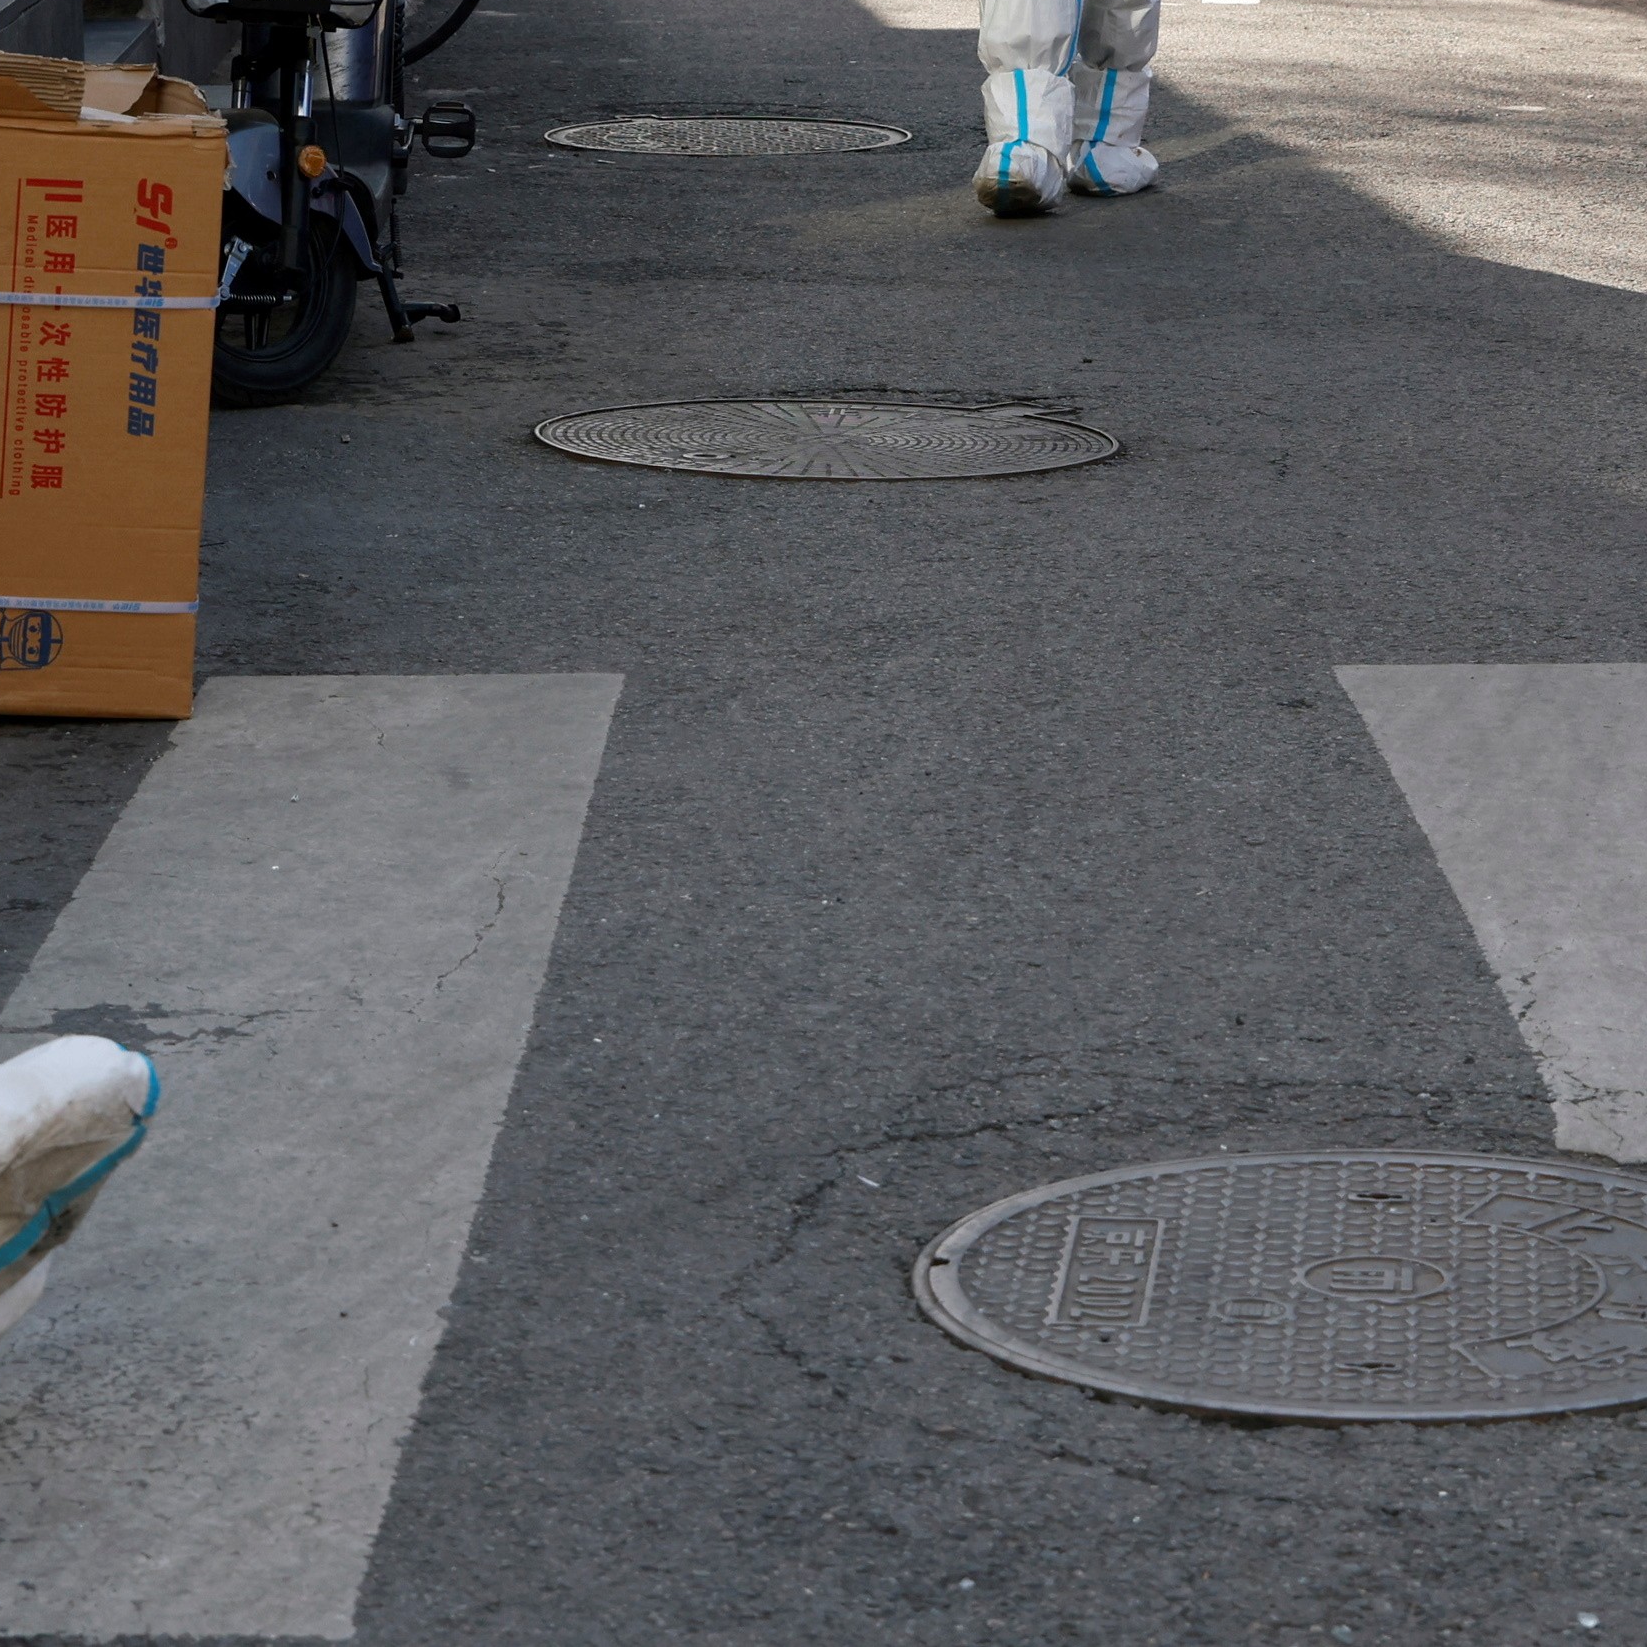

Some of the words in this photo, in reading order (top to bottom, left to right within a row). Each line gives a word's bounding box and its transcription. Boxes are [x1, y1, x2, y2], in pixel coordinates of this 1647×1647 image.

[25, 215, 39, 268] Medical
[18, 276, 35, 352] disosable
[13, 359, 29, 432] protective
[9, 438, 25, 497] clothing
[1069, 1271, 1136, 1318] 2002
